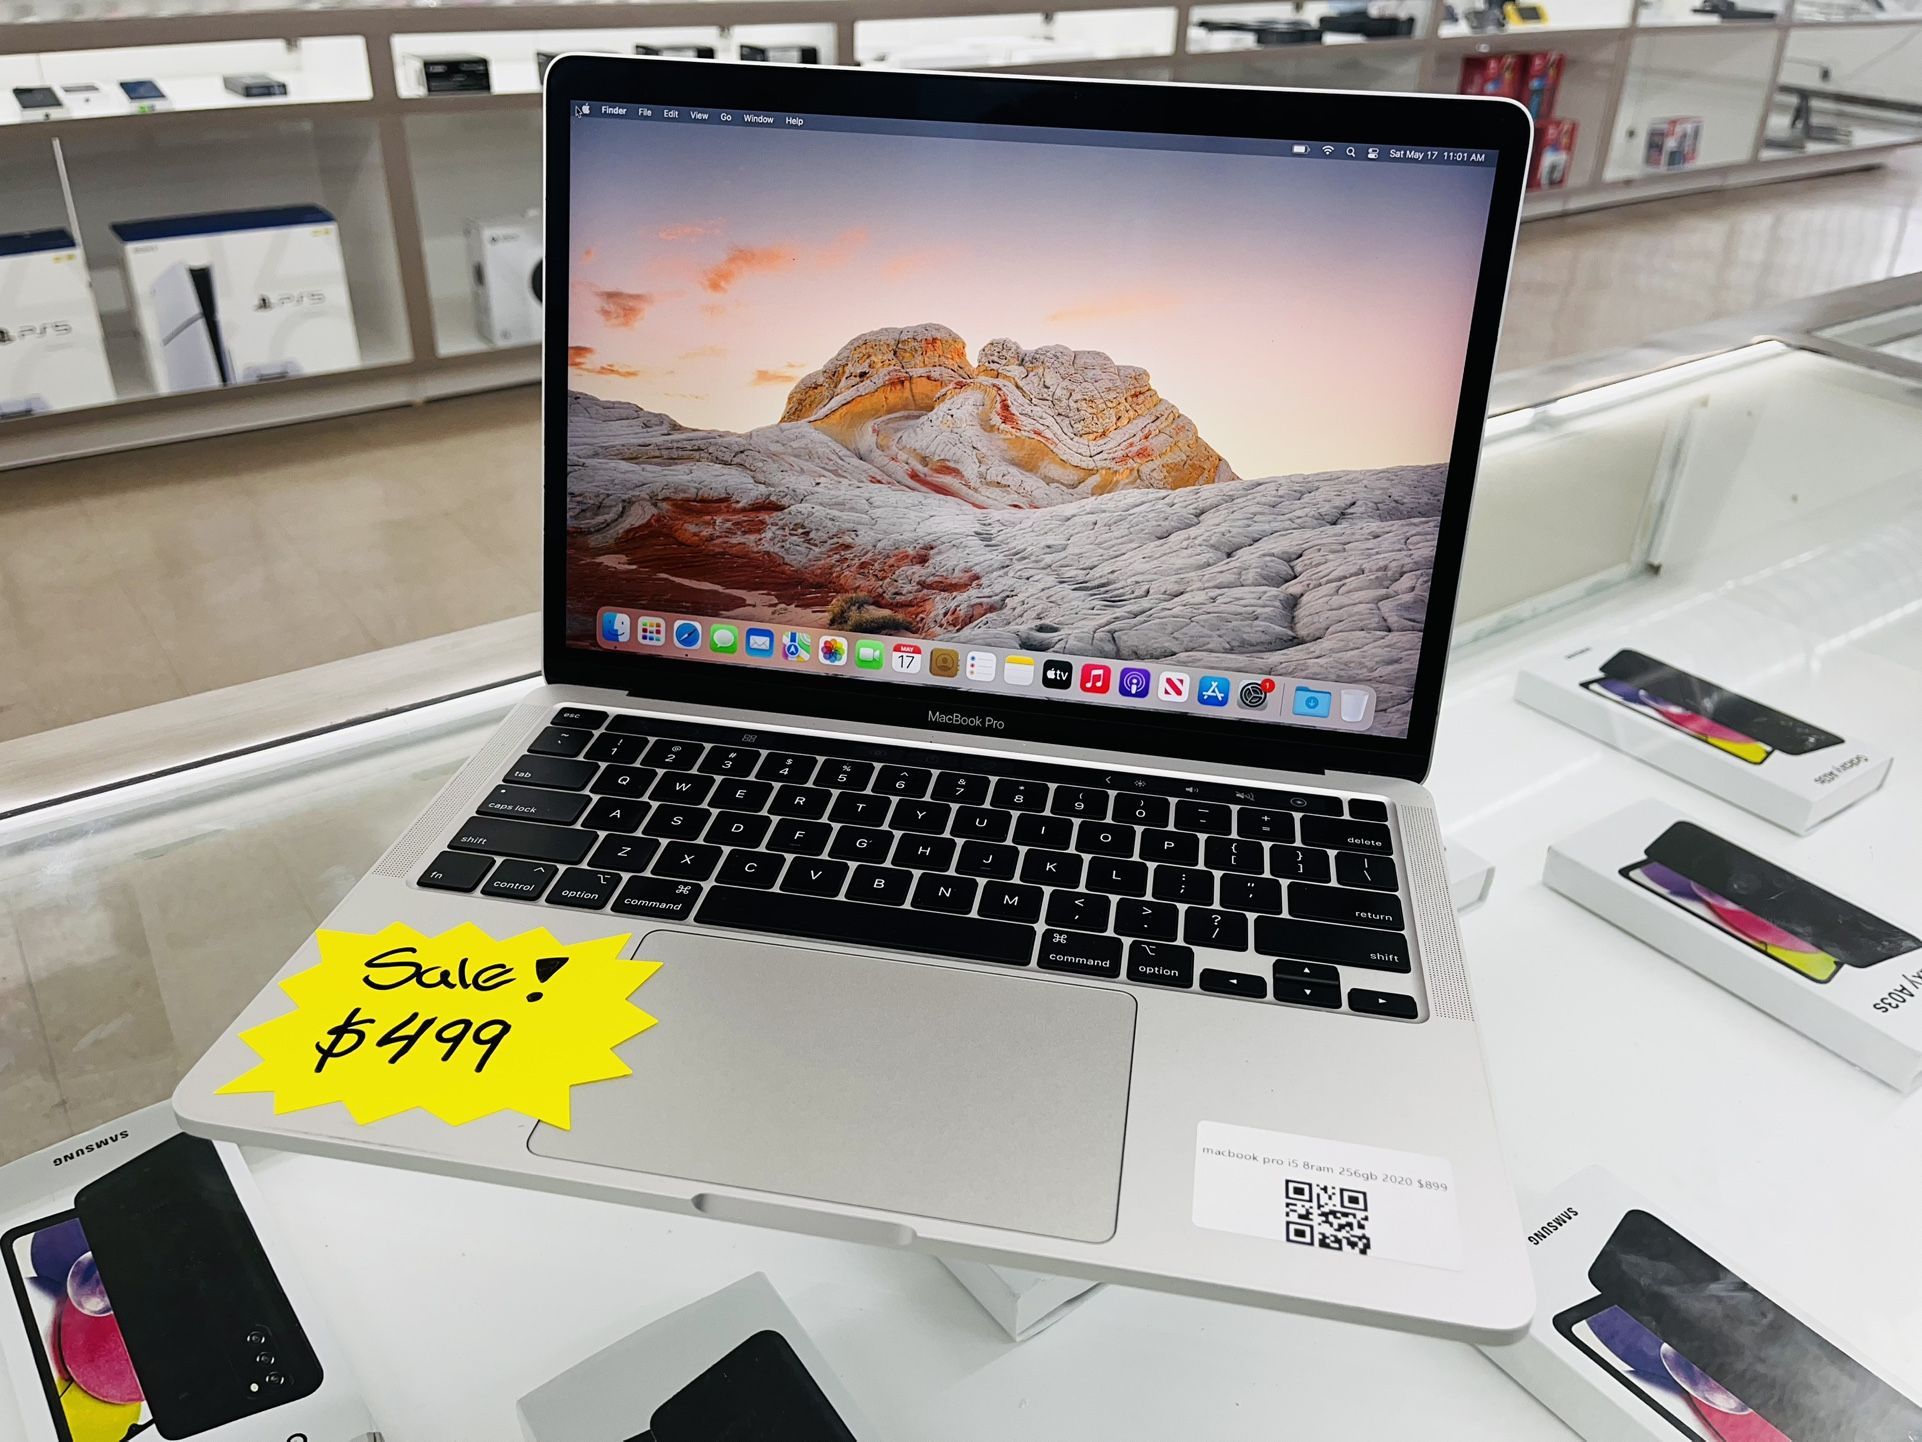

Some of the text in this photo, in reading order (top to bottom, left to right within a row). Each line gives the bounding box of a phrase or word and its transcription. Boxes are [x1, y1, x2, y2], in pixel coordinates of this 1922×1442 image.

[602, 106, 803, 126] Finder File Edit View Go Window Help
[1390, 149, 1485, 161] Sat May 17 11:01 AM
[898, 654, 914, 669] 17
[928, 710, 1004, 729] MacBook Pro
[514, 770, 532, 778] tab
[488, 802, 537, 814] caps lock
[460, 836, 488, 845] shift
[1347, 836, 1382, 847] delete
[429, 871, 443, 880] fn
[493, 880, 536, 892] control
[561, 889, 599, 900] option
[623, 896, 684, 913] command
[1355, 911, 1393, 922] return
[1049, 953, 1110, 968] command
[1369, 952, 1400, 963] shift
[362, 946, 569, 1003] Sale!
[1138, 965, 1179, 977] option
[1873, 984, 1914, 1013] A03s
[314, 1007, 512, 1074] $499
[52, 1129, 130, 1168] SAMSUNG
[1202, 1145, 1448, 1192] macbook pro i5 8ram 256gb 2020 $899
[1527, 1206, 1579, 1247] SAMSUNG
